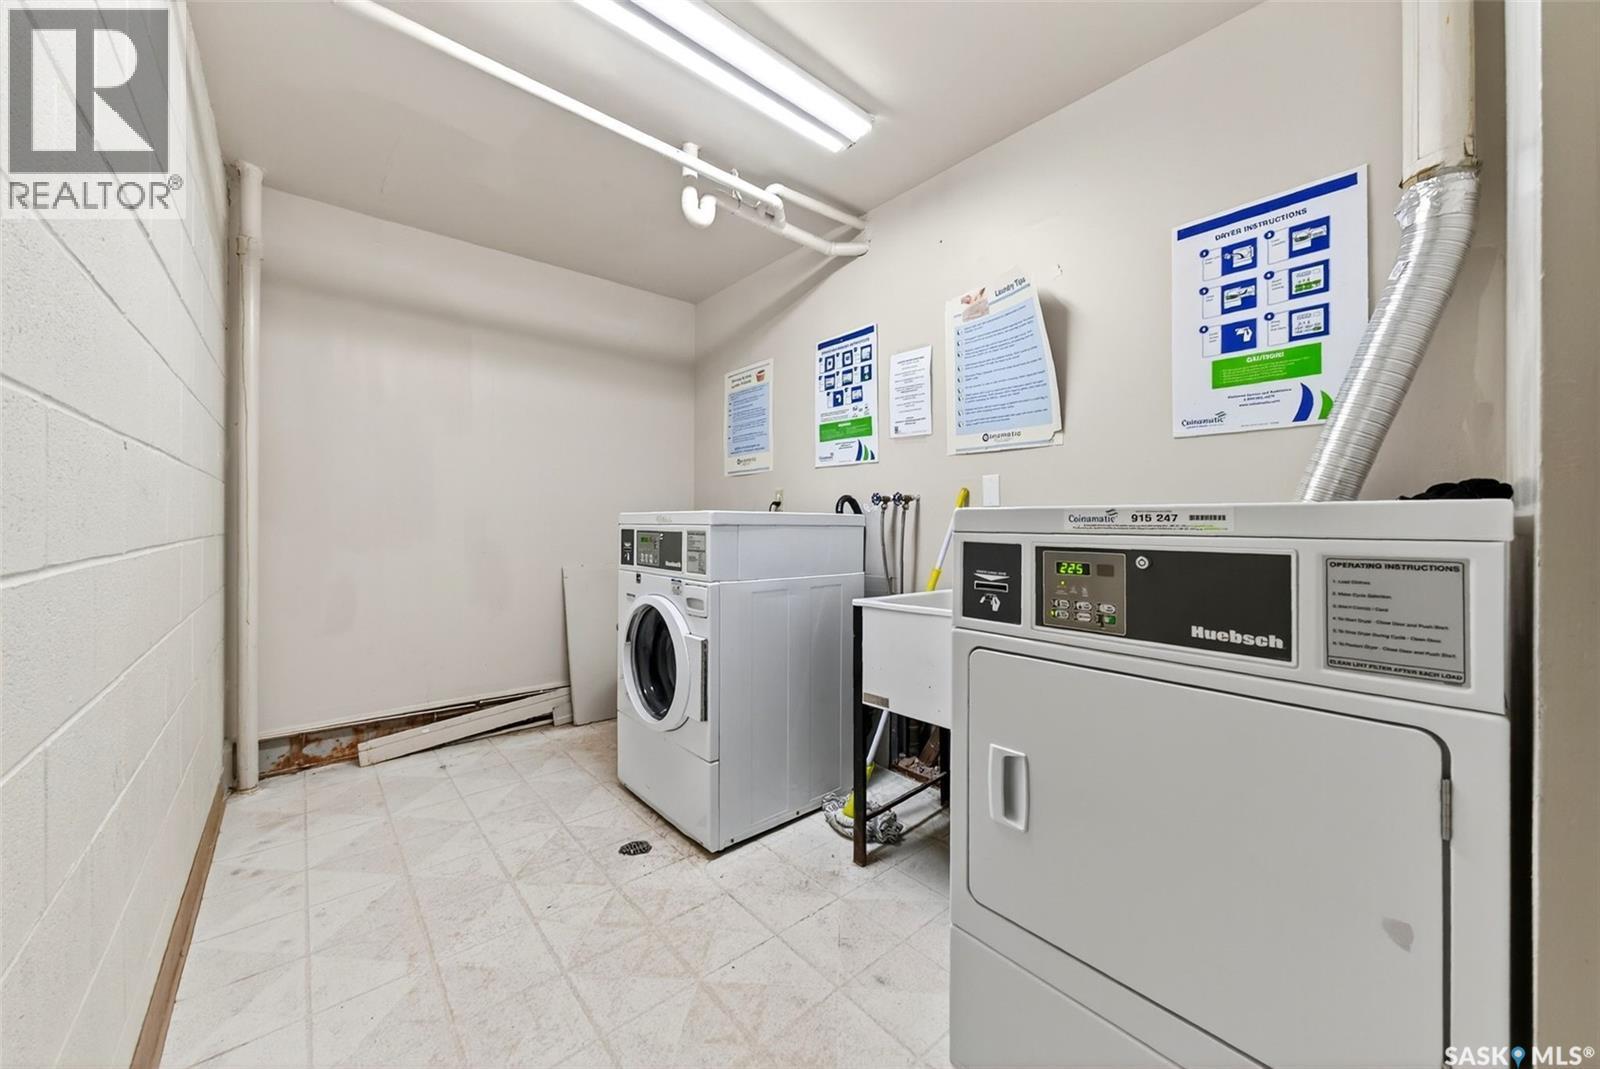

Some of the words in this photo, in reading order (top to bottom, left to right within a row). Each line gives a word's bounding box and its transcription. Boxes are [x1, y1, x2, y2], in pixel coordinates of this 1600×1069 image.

[1215, 228, 1242, 241] DRYER
[1243, 208, 1308, 232] INSTRUCTIONS
[1014, 277, 1026, 287] Tips
[1068, 513, 1115, 524] Coinamatic
[1131, 513, 1152, 523] 915
[1156, 513, 1178, 523] 247
[1060, 562, 1084, 575] 225
[1329, 561, 1382, 570] OPERATING
[1384, 563, 1461, 573] INSTRUCTIONS
[1190, 625, 1285, 650] Huebsch
[1329, 658, 1351, 667] CLEAN
[1352, 661, 1367, 669] LINT
[1368, 663, 1392, 672] FILTER
[1393, 666, 1417, 676] AFTER
[1418, 670, 1440, 678] EACH
[1441, 673, 1463, 681] LOAD
